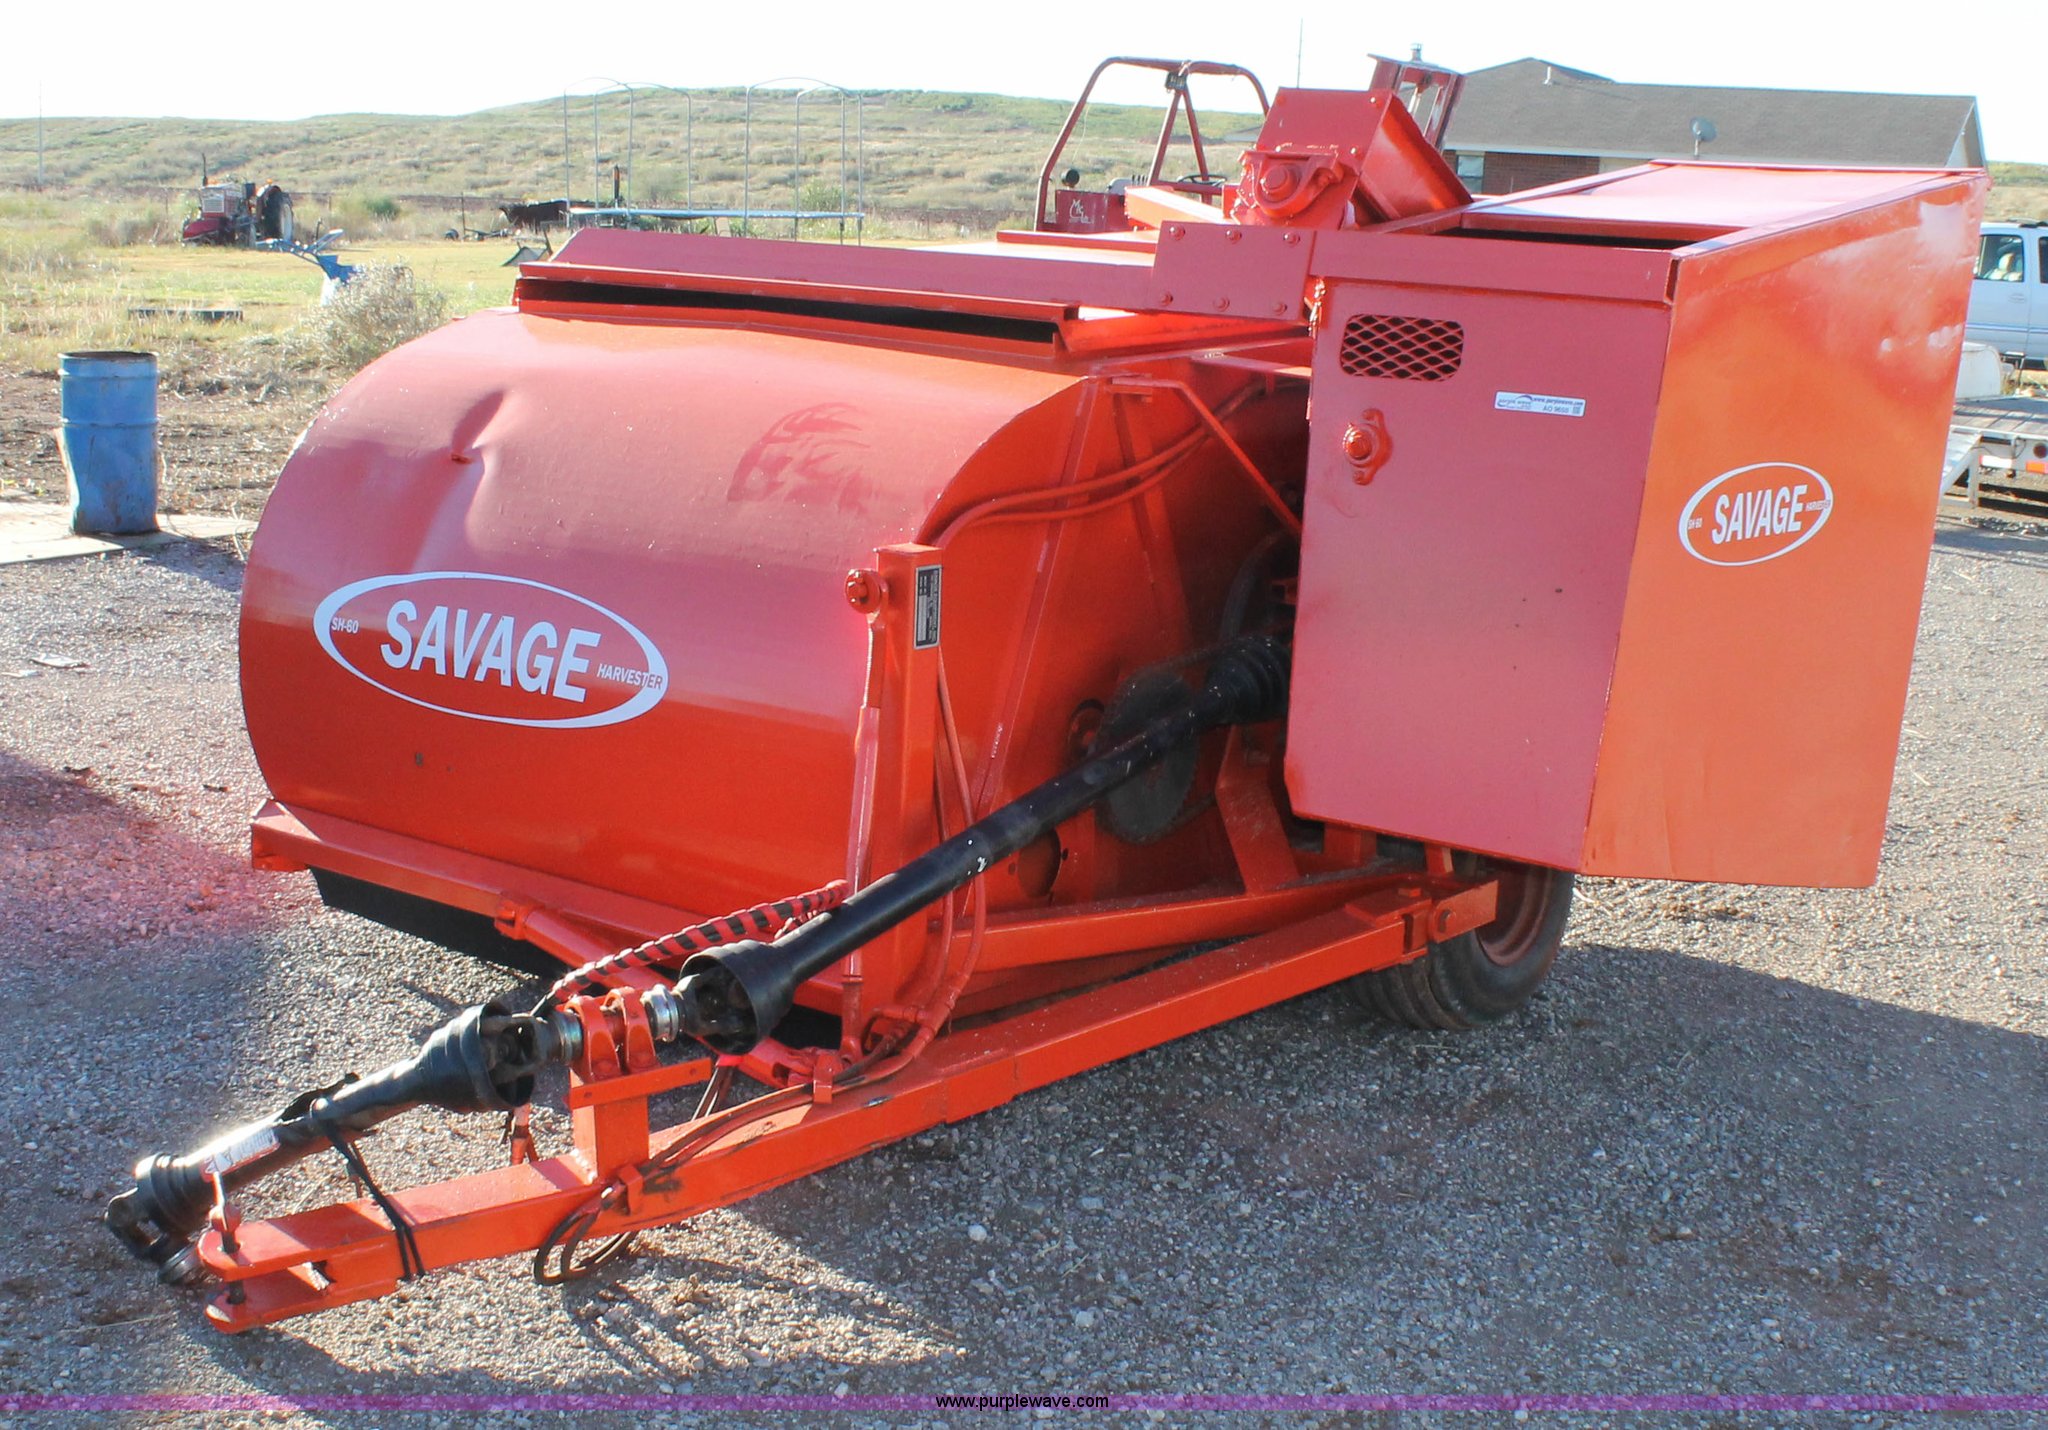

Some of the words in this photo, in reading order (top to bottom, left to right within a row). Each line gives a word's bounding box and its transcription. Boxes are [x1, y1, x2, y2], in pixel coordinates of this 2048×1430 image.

[1712, 484, 1808, 544] SAVAGE
[331, 617, 359, 634] SH-60
[381, 600, 601, 703] SAVAGE
[597, 663, 663, 690] HARVESTER
